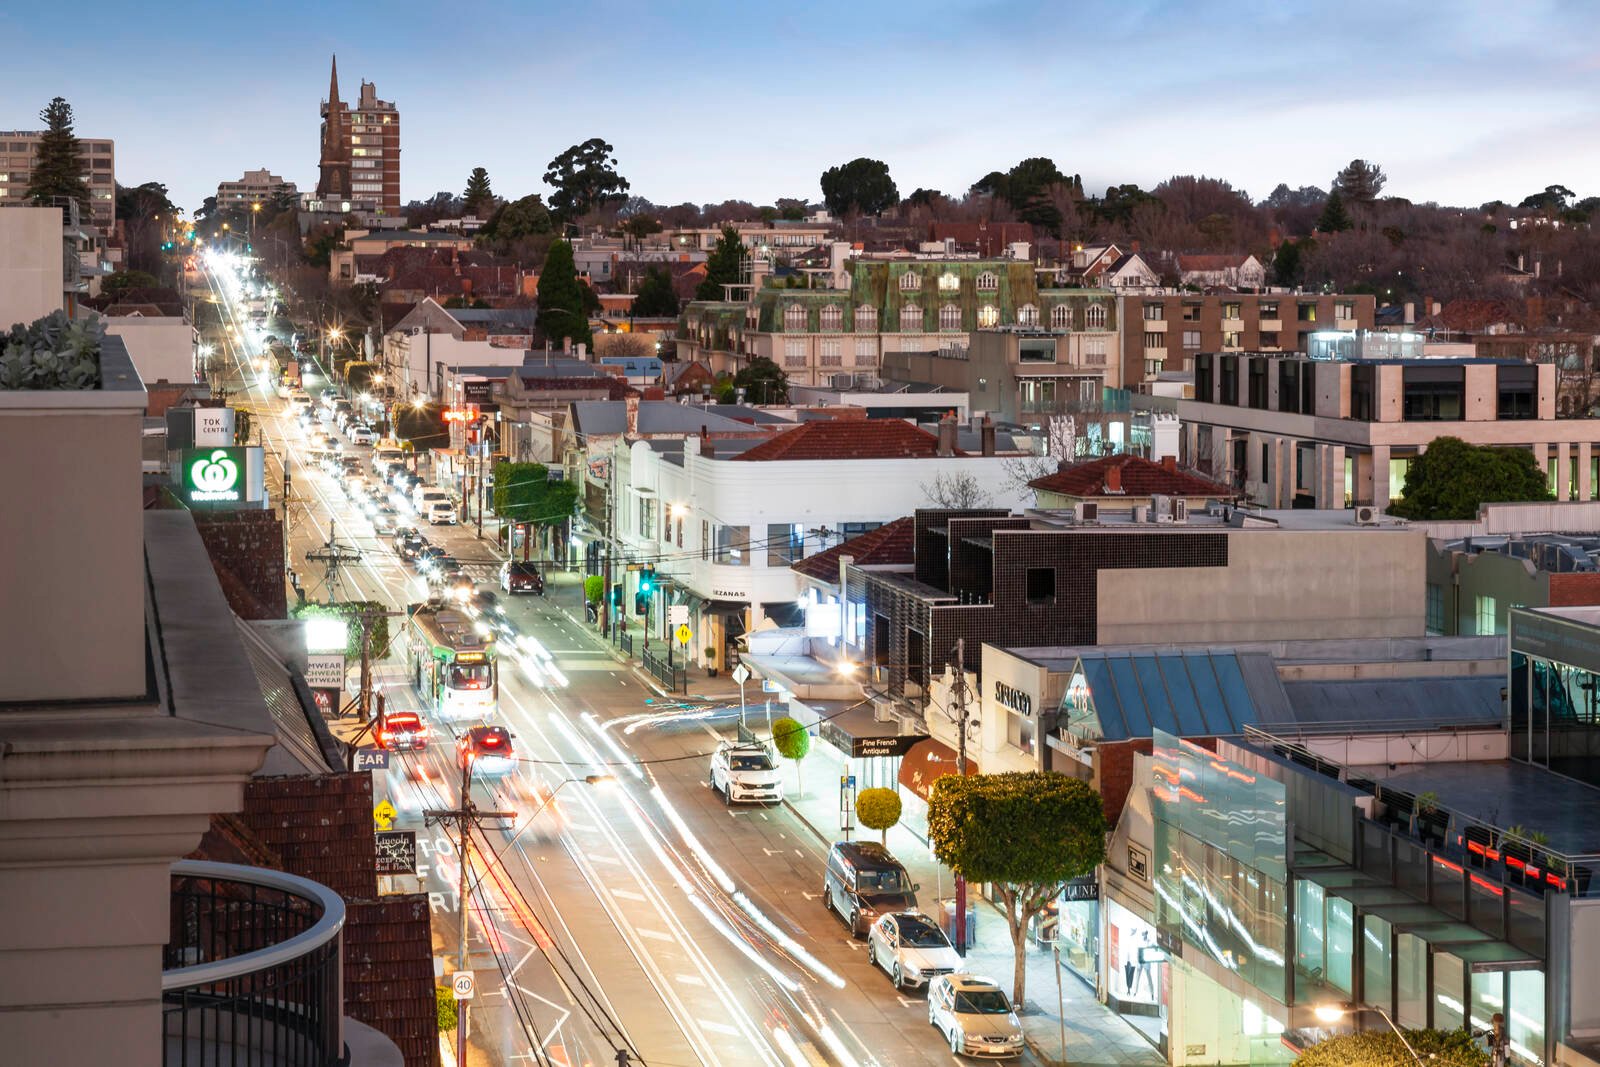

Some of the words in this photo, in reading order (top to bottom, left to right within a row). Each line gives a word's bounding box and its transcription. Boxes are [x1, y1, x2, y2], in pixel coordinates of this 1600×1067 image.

[203, 418, 220, 426] TOK
[862, 747, 890, 755] Antiques
[375, 833, 409, 846] Lincoln
[1067, 884, 1097, 897] LUNE
[457, 980, 471, 990] 40
